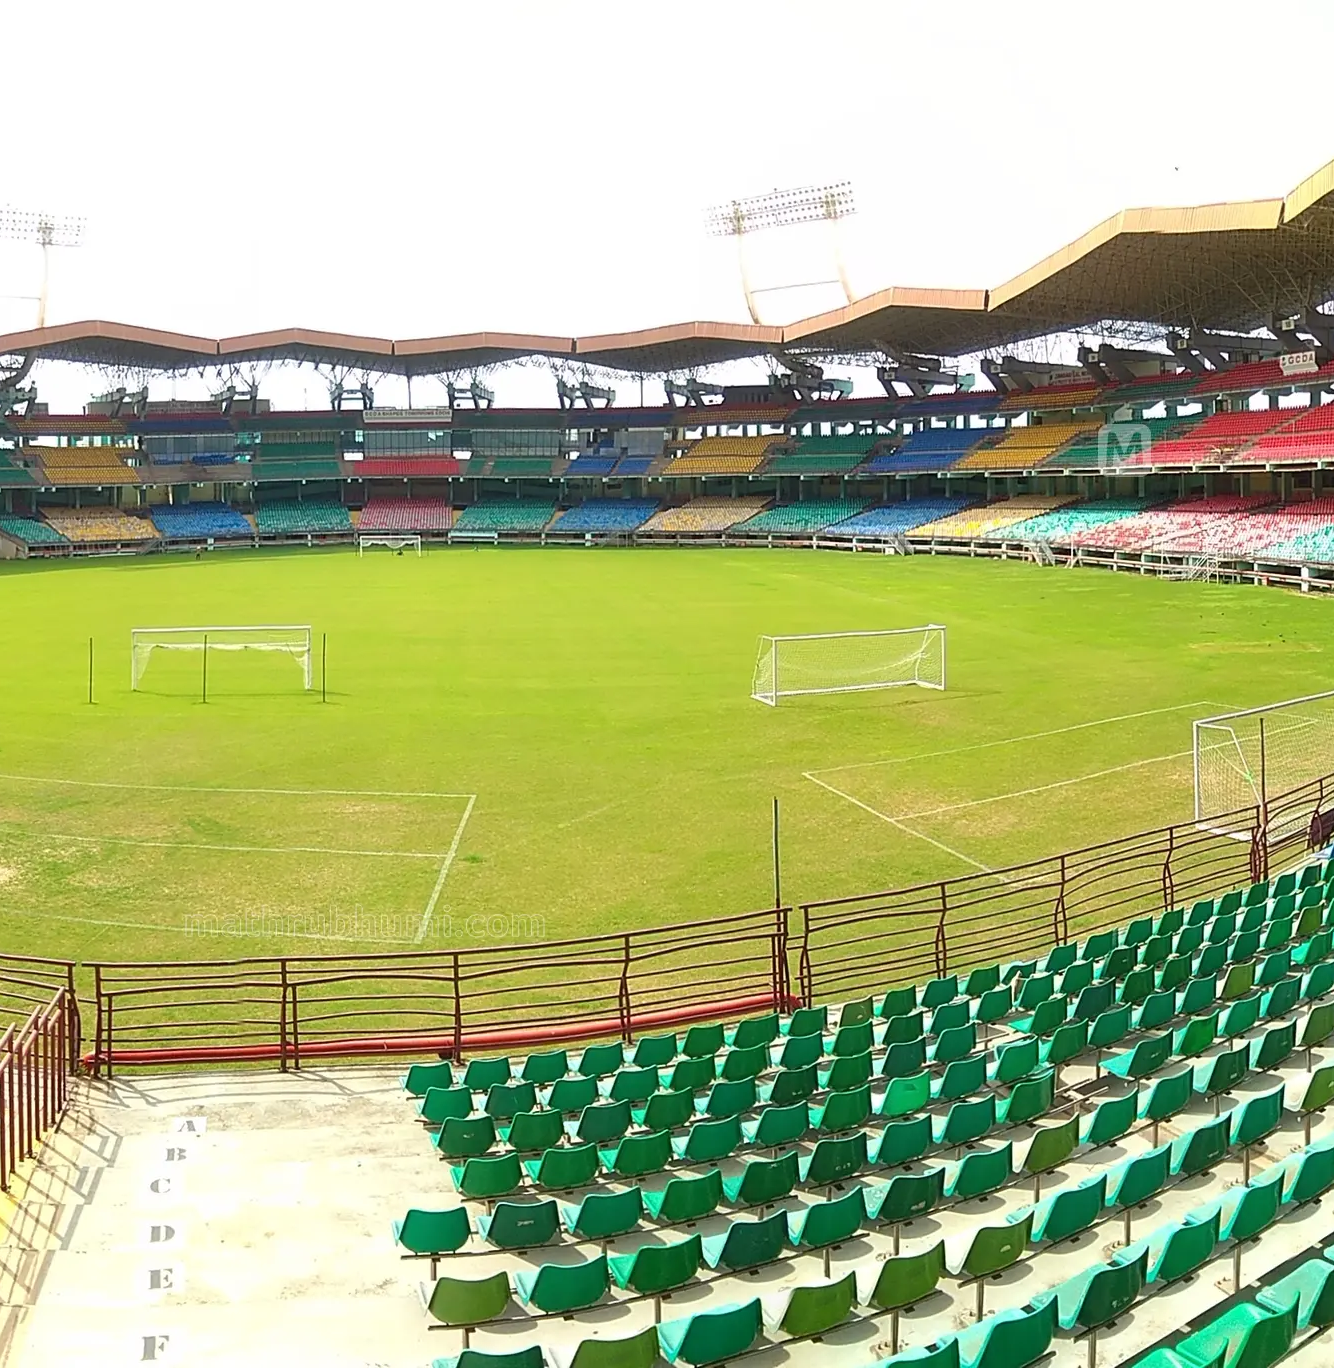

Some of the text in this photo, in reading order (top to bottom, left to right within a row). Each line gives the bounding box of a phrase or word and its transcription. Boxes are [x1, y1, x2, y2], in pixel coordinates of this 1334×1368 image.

[1287, 354, 1314, 365] GCDA
[177, 1120, 196, 1132] A
[165, 1147, 187, 1161] B
[150, 1178, 171, 1193] C
[150, 1225, 175, 1243] D
[148, 1268, 173, 1290] E
[140, 1335, 169, 1361] F
